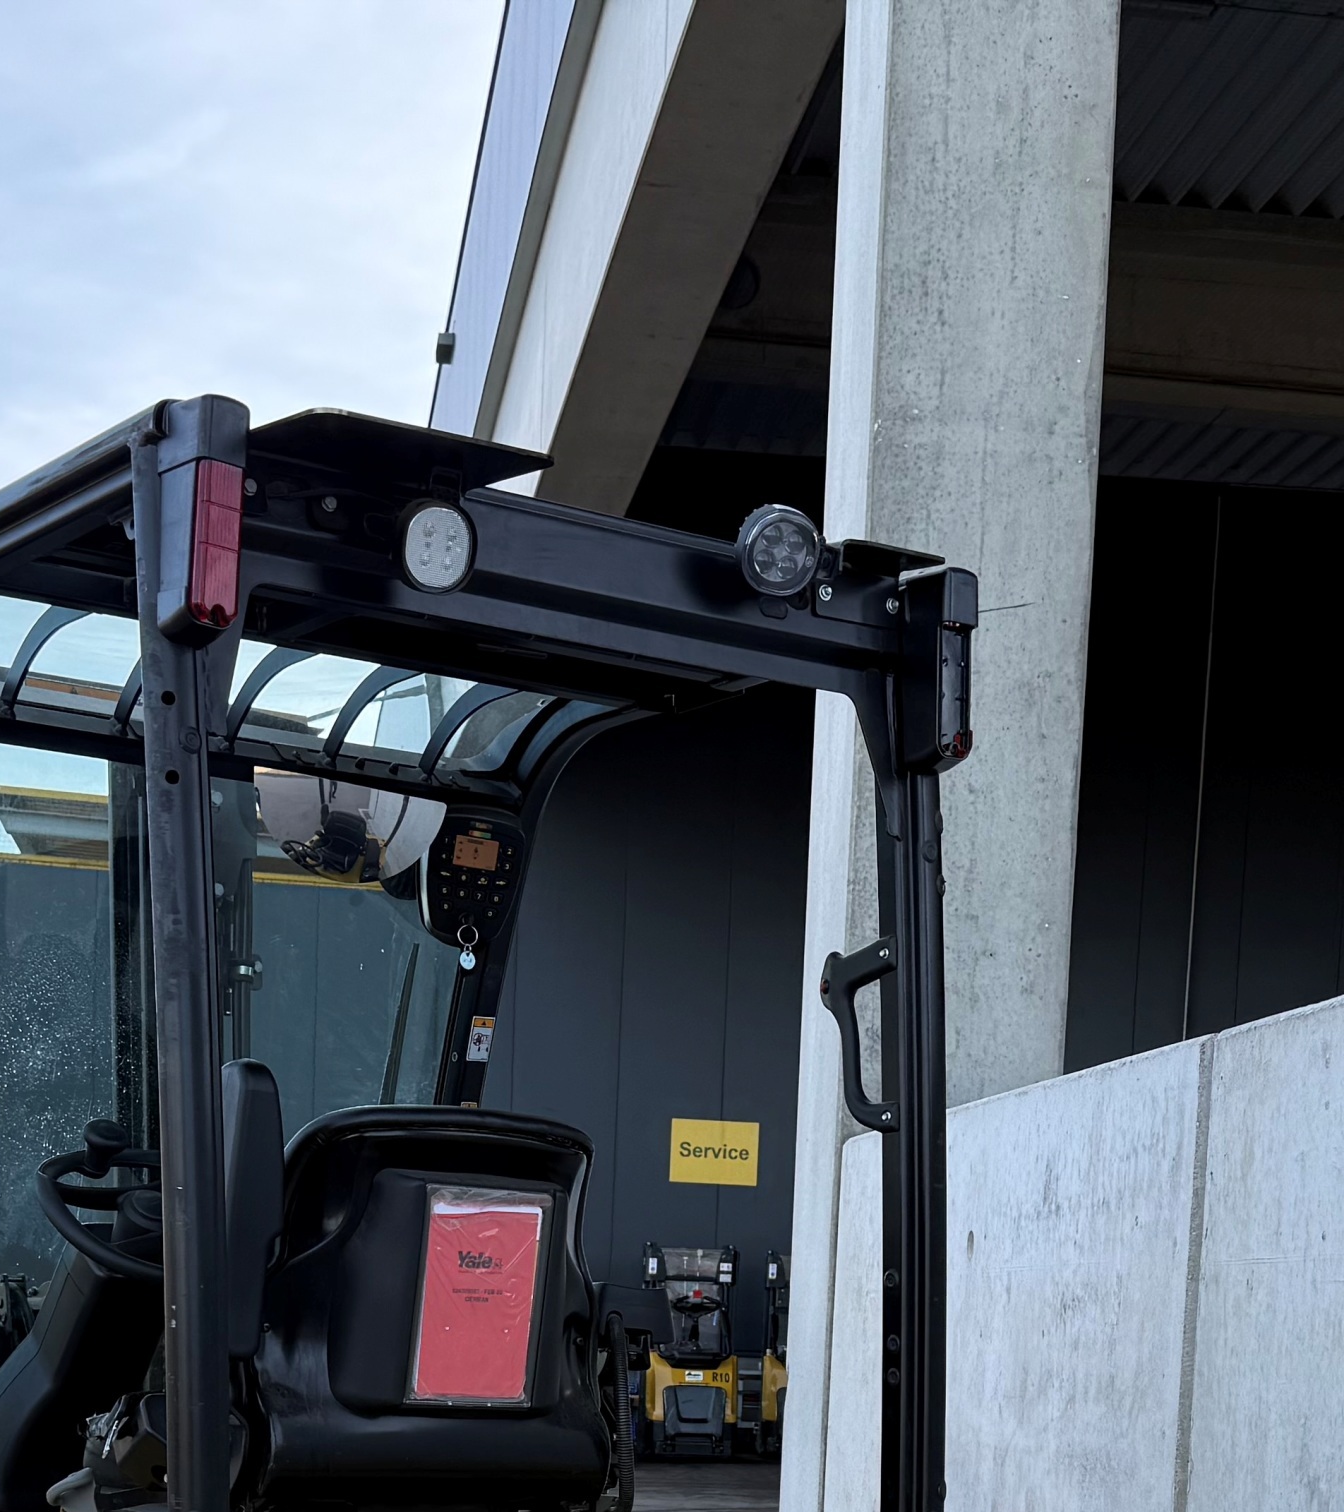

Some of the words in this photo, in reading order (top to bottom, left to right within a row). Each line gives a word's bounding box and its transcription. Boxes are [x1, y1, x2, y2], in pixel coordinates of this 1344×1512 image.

[679, 1141, 750, 1161] Service
[458, 1251, 492, 1269] Yale
[712, 1372, 730, 1383] R10
